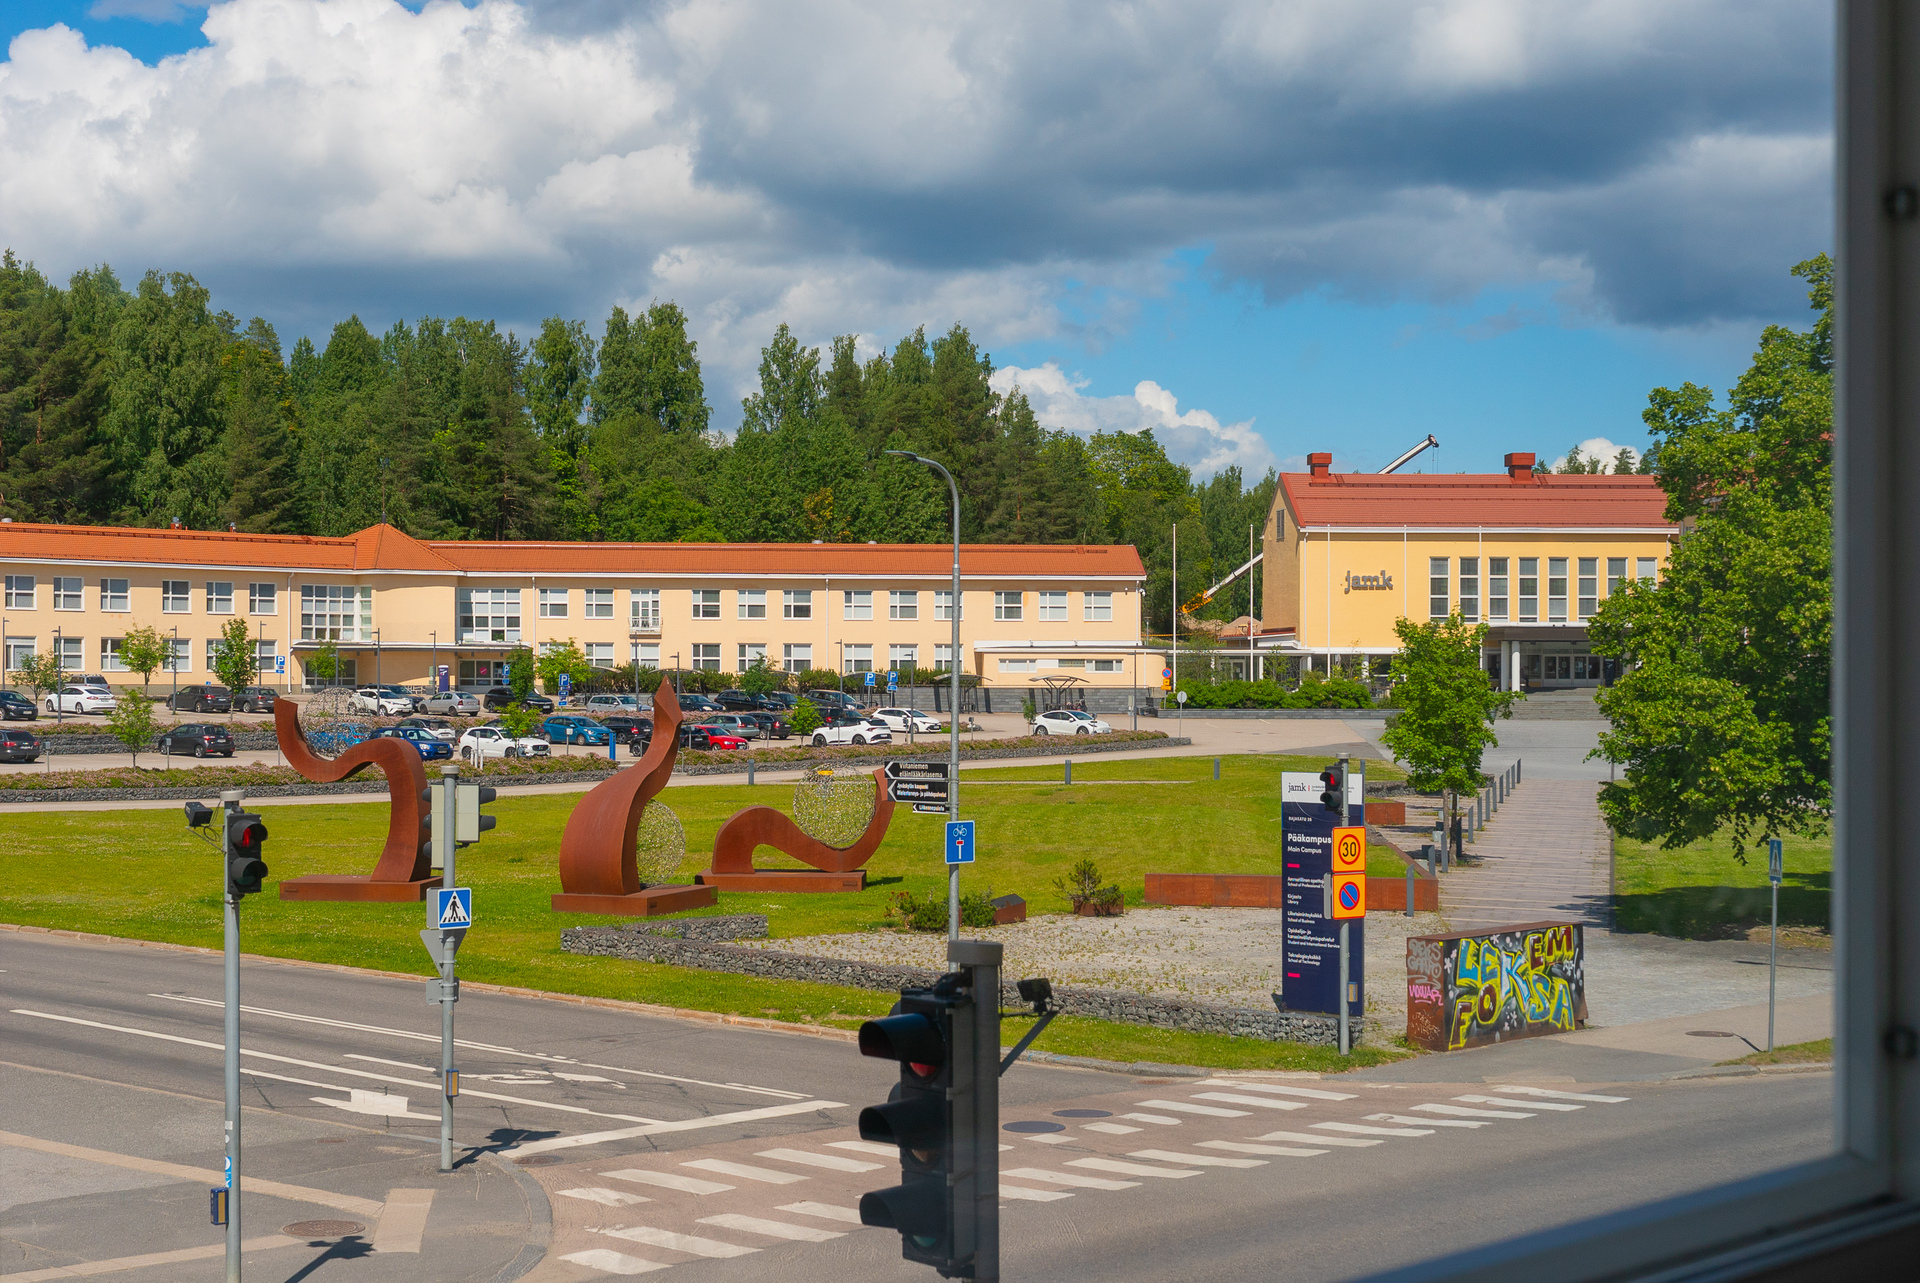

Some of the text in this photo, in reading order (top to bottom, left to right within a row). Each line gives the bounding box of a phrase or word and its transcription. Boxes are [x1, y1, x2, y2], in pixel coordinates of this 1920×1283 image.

[1344, 570, 1393, 594] jamk
[1288, 783, 1306, 793] jamk
[1288, 833, 1332, 845] Pääkampus
[1342, 842, 1356, 857] 30
